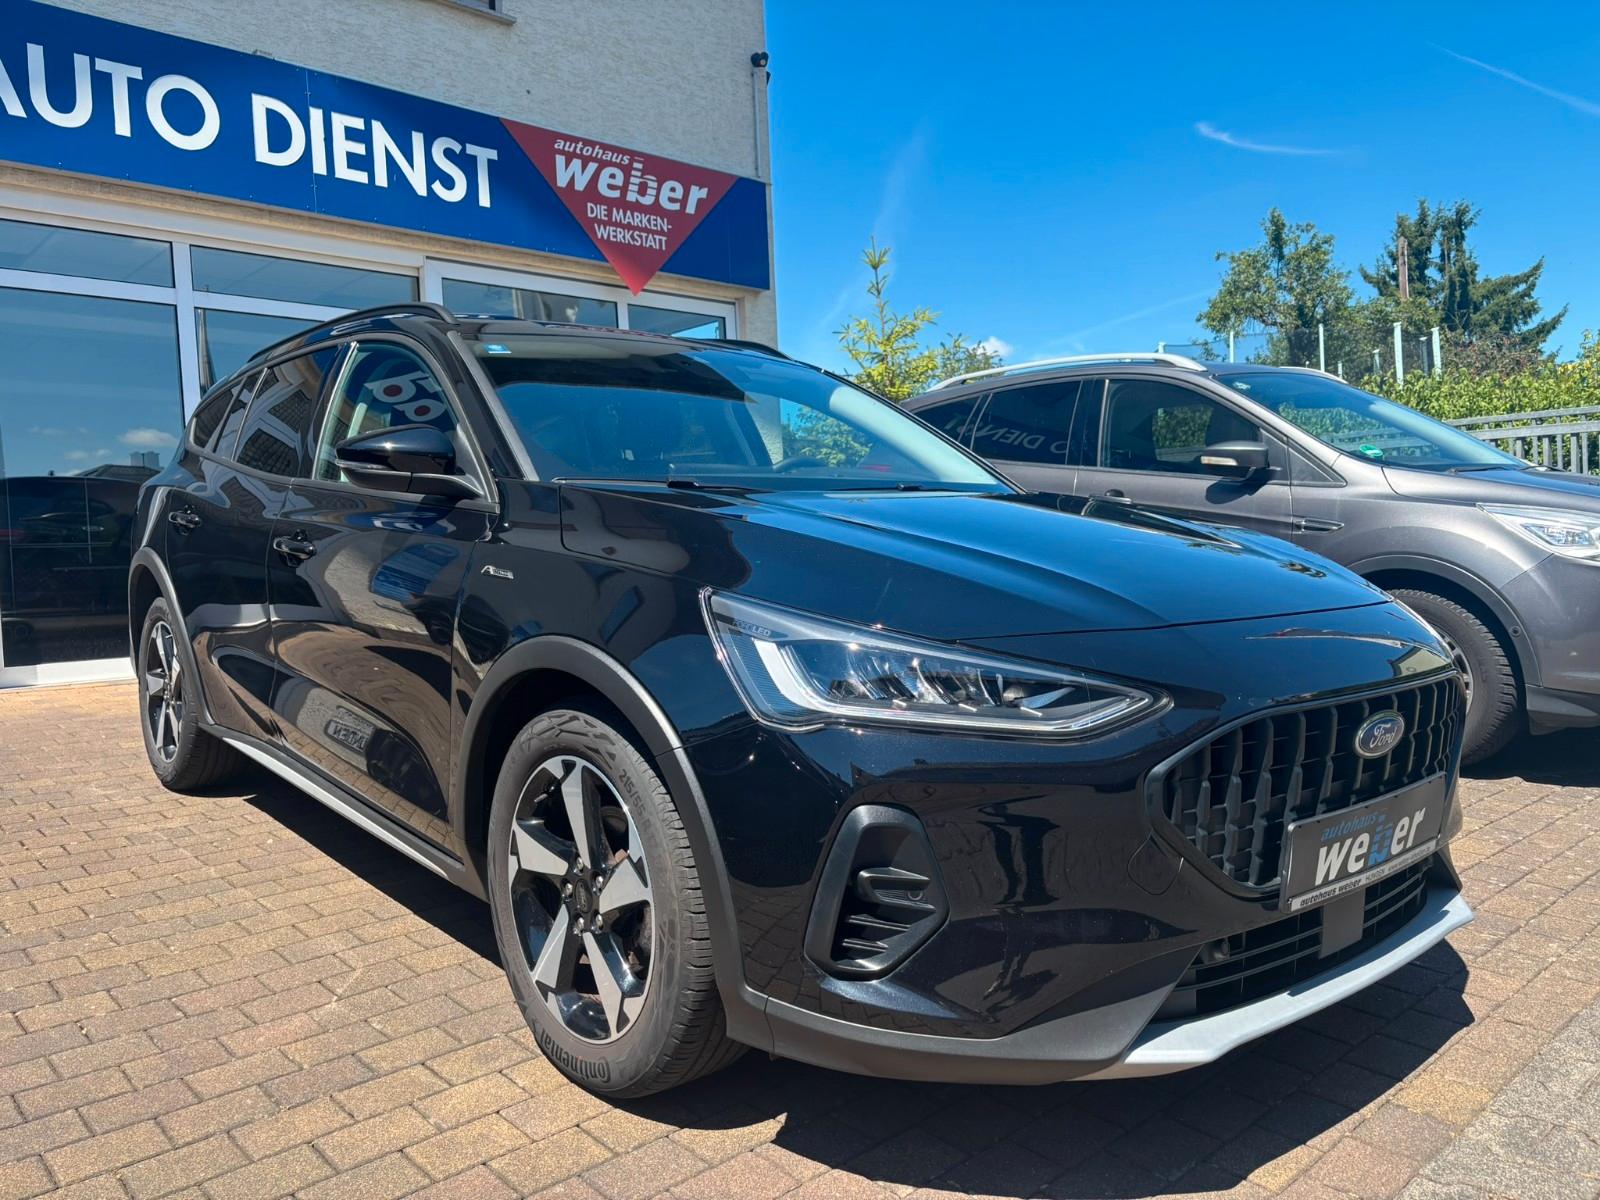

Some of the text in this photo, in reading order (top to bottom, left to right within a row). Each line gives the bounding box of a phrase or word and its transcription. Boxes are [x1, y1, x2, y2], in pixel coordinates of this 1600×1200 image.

[251, 93, 498, 208] DIENST
[554, 139, 631, 165] autohaus
[555, 154, 709, 215] weber
[587, 202, 673, 232] DIE MARKEN-
[594, 223, 668, 251] WERKSTATT
[1370, 722, 1398, 748] Ford
[1321, 811, 1378, 841] autohaus
[1315, 806, 1427, 887] weber
[1300, 884, 1338, 907] autohaus
[540, 1027, 612, 1084] Continental
